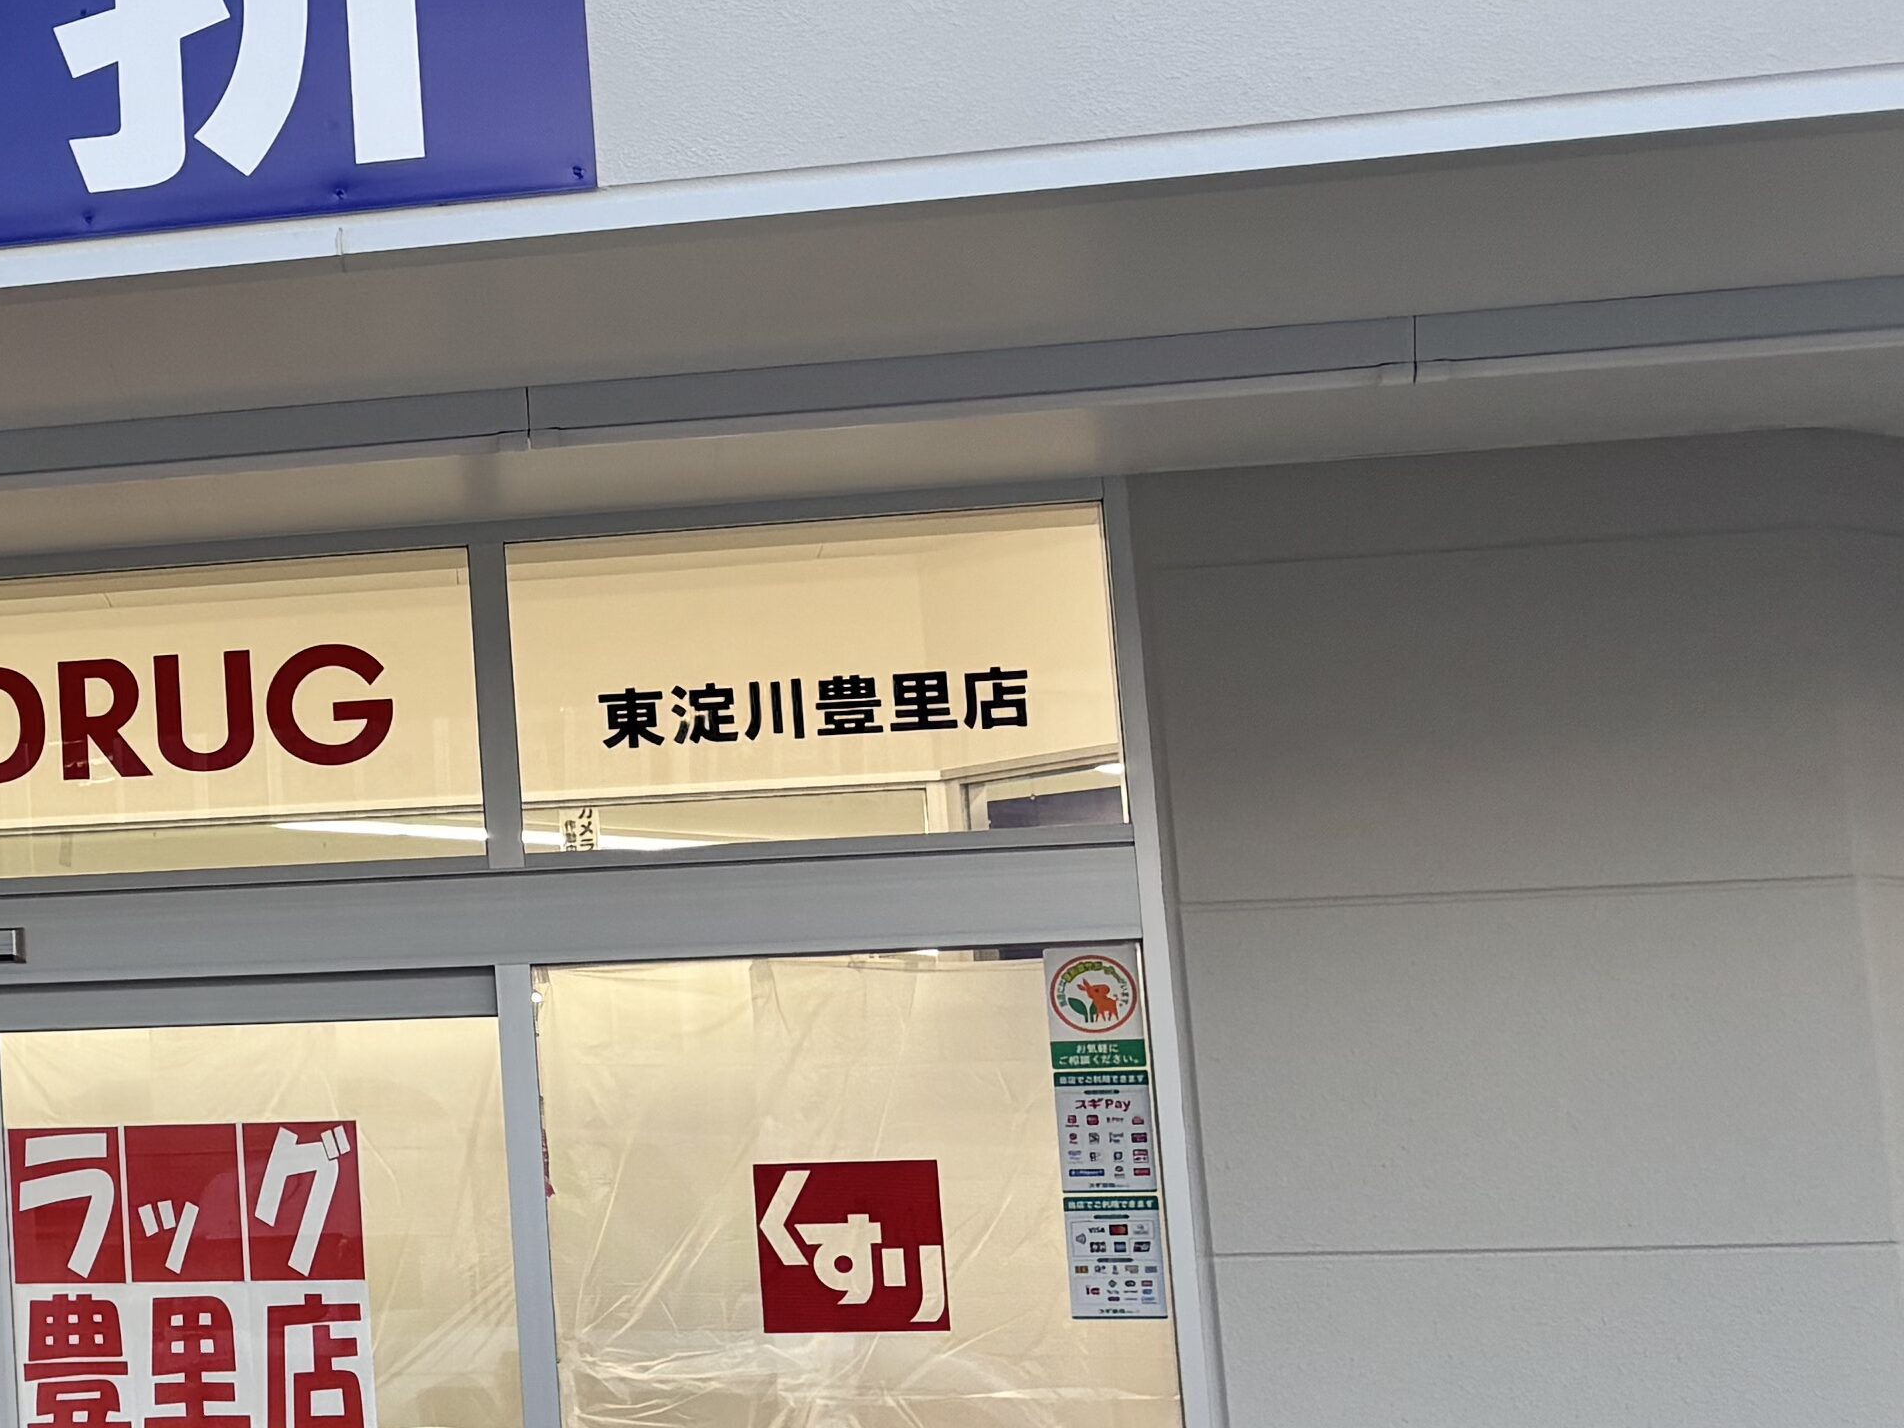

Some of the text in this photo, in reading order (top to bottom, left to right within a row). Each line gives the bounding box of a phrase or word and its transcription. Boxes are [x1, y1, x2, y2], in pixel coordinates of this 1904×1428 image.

[598, 666, 1029, 749] 東淀川豊里店
[759, 1169, 946, 1324] くすり
